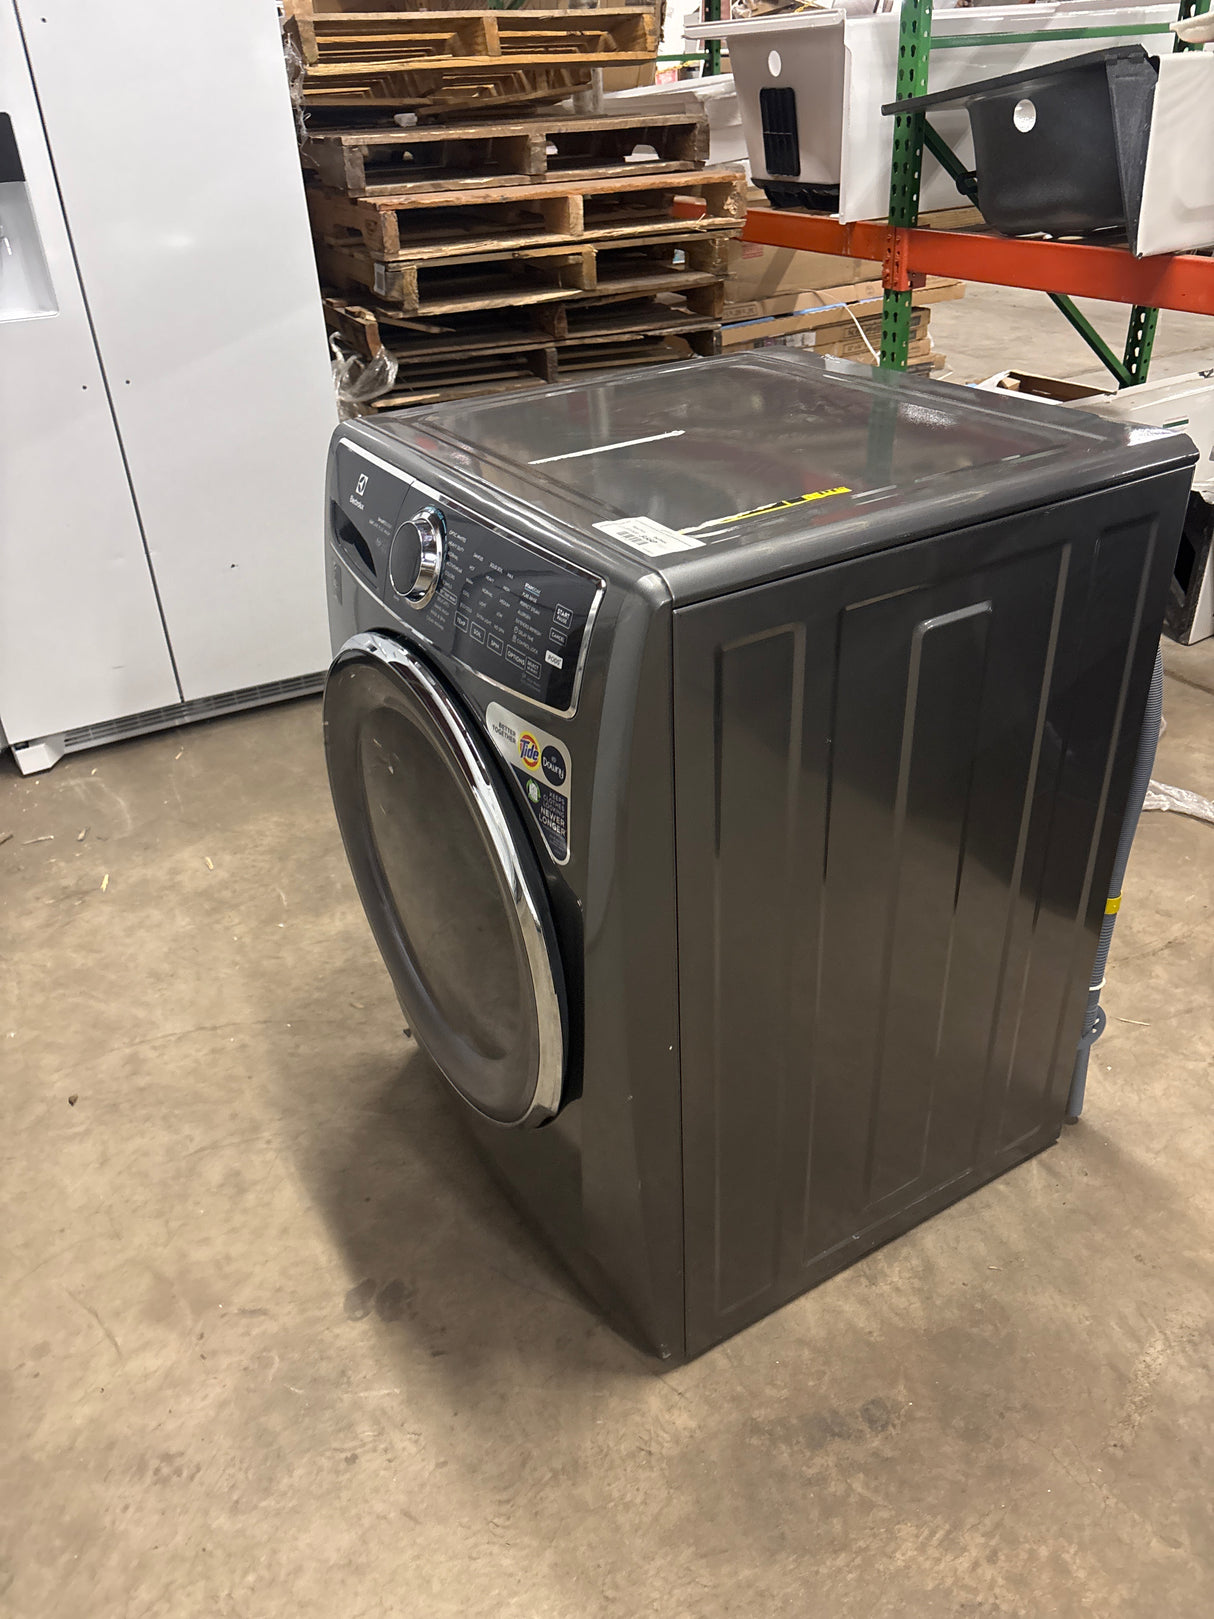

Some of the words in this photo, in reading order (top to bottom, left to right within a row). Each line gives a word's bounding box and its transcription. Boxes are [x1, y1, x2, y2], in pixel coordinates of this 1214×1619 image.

[556, 607, 571, 619] START
[507, 650, 526, 667] OPTIONS
[492, 724, 517, 745] TOGETHER
[498, 721, 516, 737] BETTER
[520, 738, 539, 761] Tide
[542, 756, 565, 780] Downy
[538, 813, 567, 837] LONGER
[540, 807, 566, 828] NEWER
